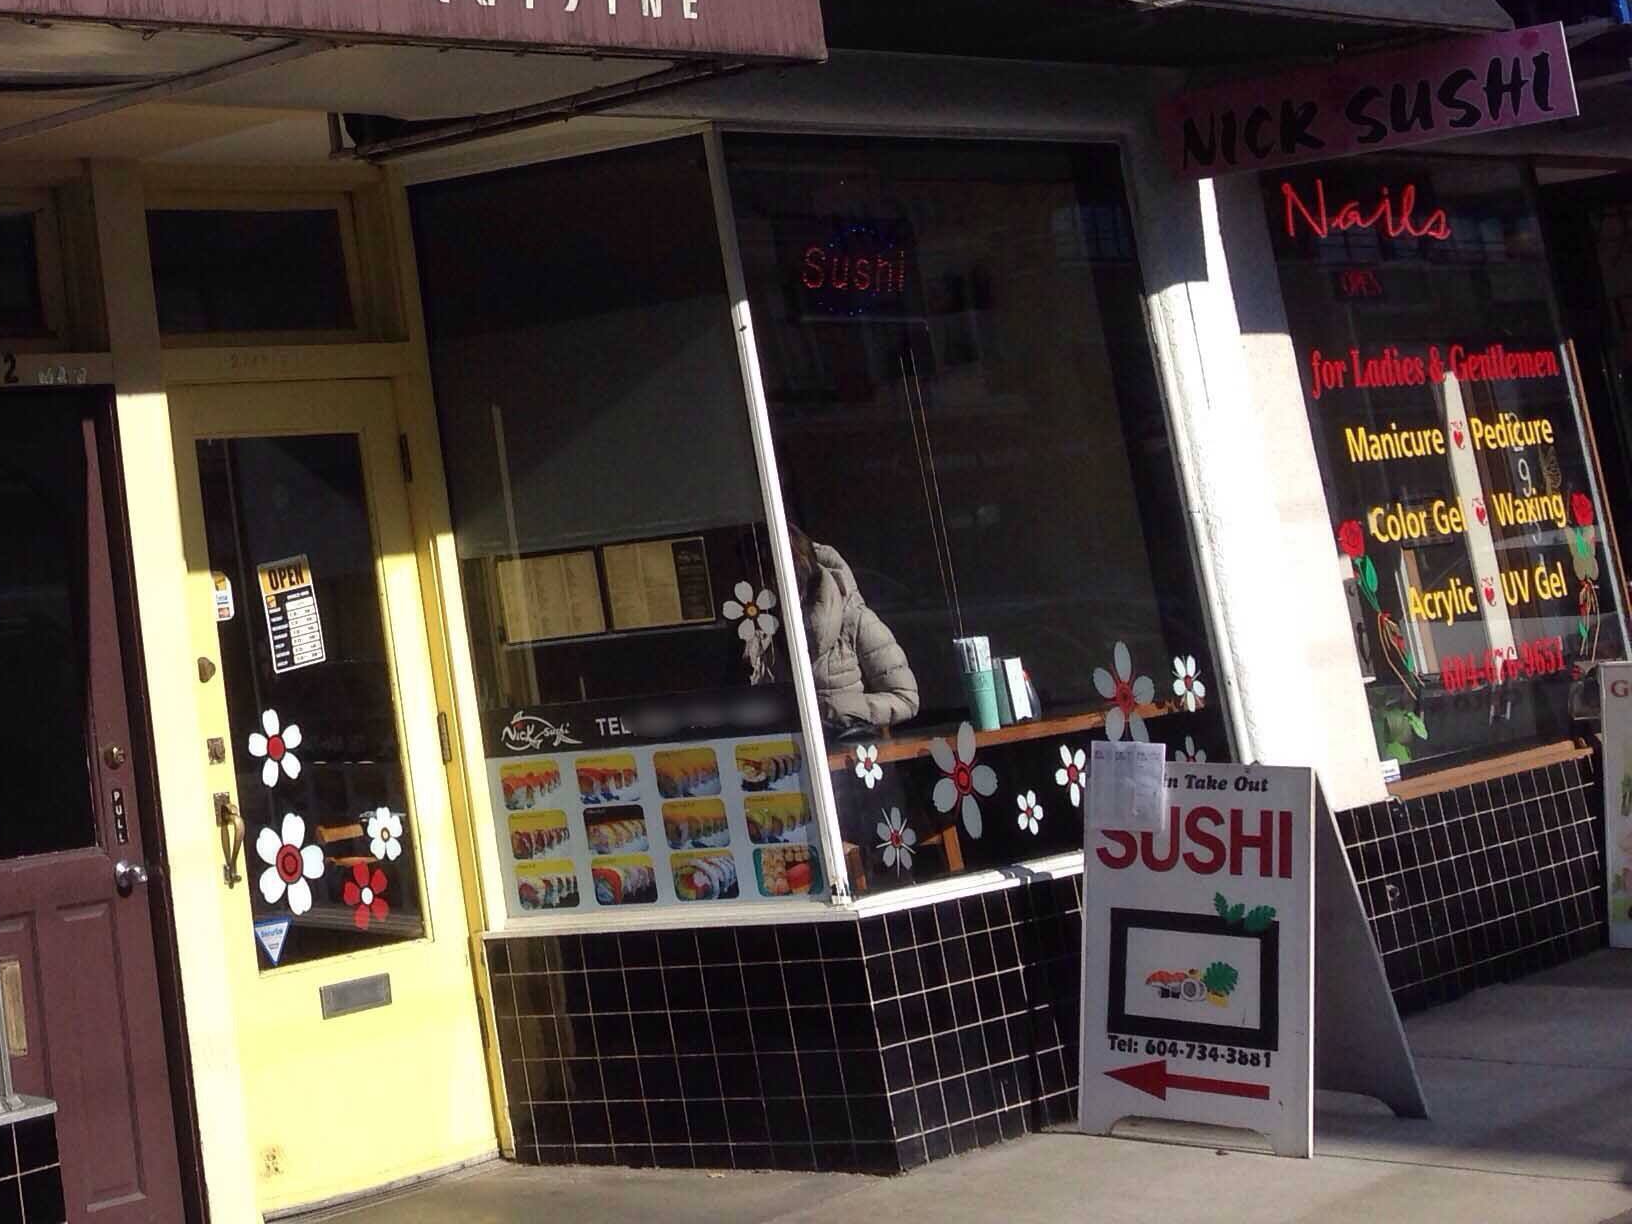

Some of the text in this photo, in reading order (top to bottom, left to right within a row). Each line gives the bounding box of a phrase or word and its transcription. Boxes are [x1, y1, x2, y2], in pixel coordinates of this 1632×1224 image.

[1183, 50, 1555, 170] NICK SUSHI
[1280, 178, 1451, 241] Nails
[1311, 343, 1560, 400] for Ladies & Gentlemen
[1344, 422, 1446, 463] Manicure
[1470, 412, 1555, 451] Pedicure
[1371, 488, 1568, 543] Color Gel Waxing
[267, 563, 305, 591] OPEN
[1407, 561, 1568, 626] Acrylic UV Gel
[1184, 774, 1228, 792] Take
[1234, 775, 1269, 792] Out
[113, 791, 125, 843] PULL
[1095, 806, 1293, 879] SUSHI
[1107, 1034, 1139, 1054] Tel:
